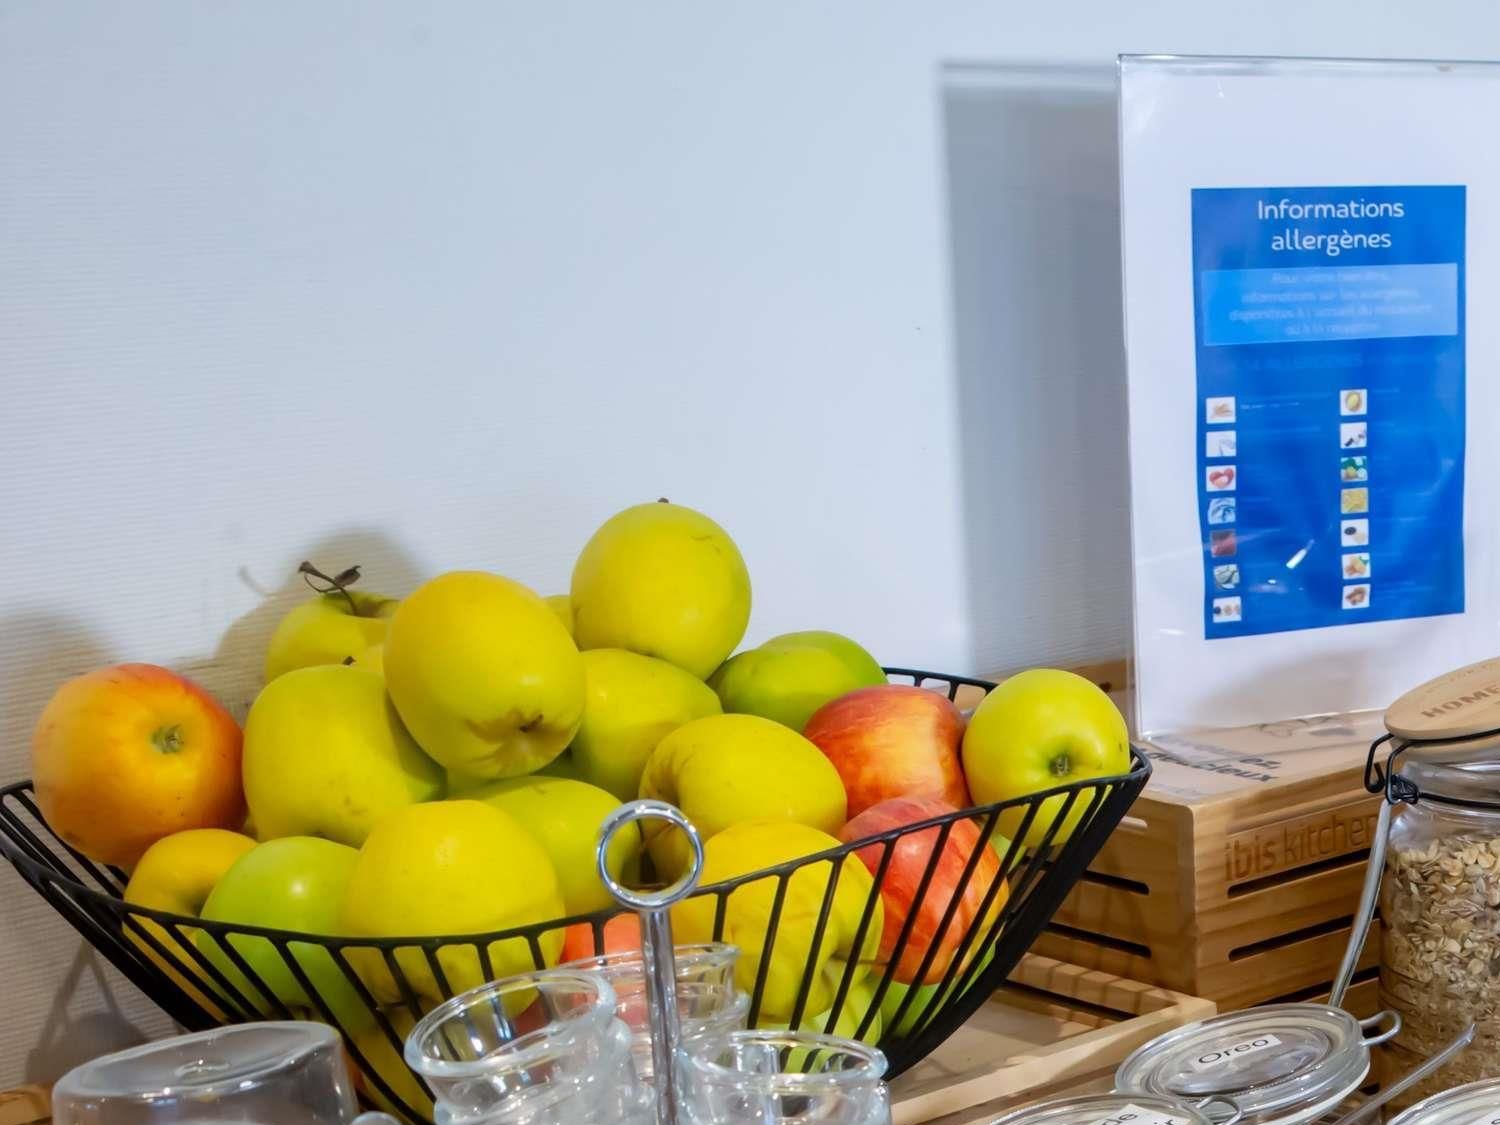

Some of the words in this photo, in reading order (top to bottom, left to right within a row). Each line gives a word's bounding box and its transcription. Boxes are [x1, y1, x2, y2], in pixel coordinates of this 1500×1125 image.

[1257, 198, 1405, 221] Informations
[1271, 228, 1392, 256] allergènes
[1224, 835, 1277, 880] ibis
[1197, 1037, 1270, 1065] Oreo
